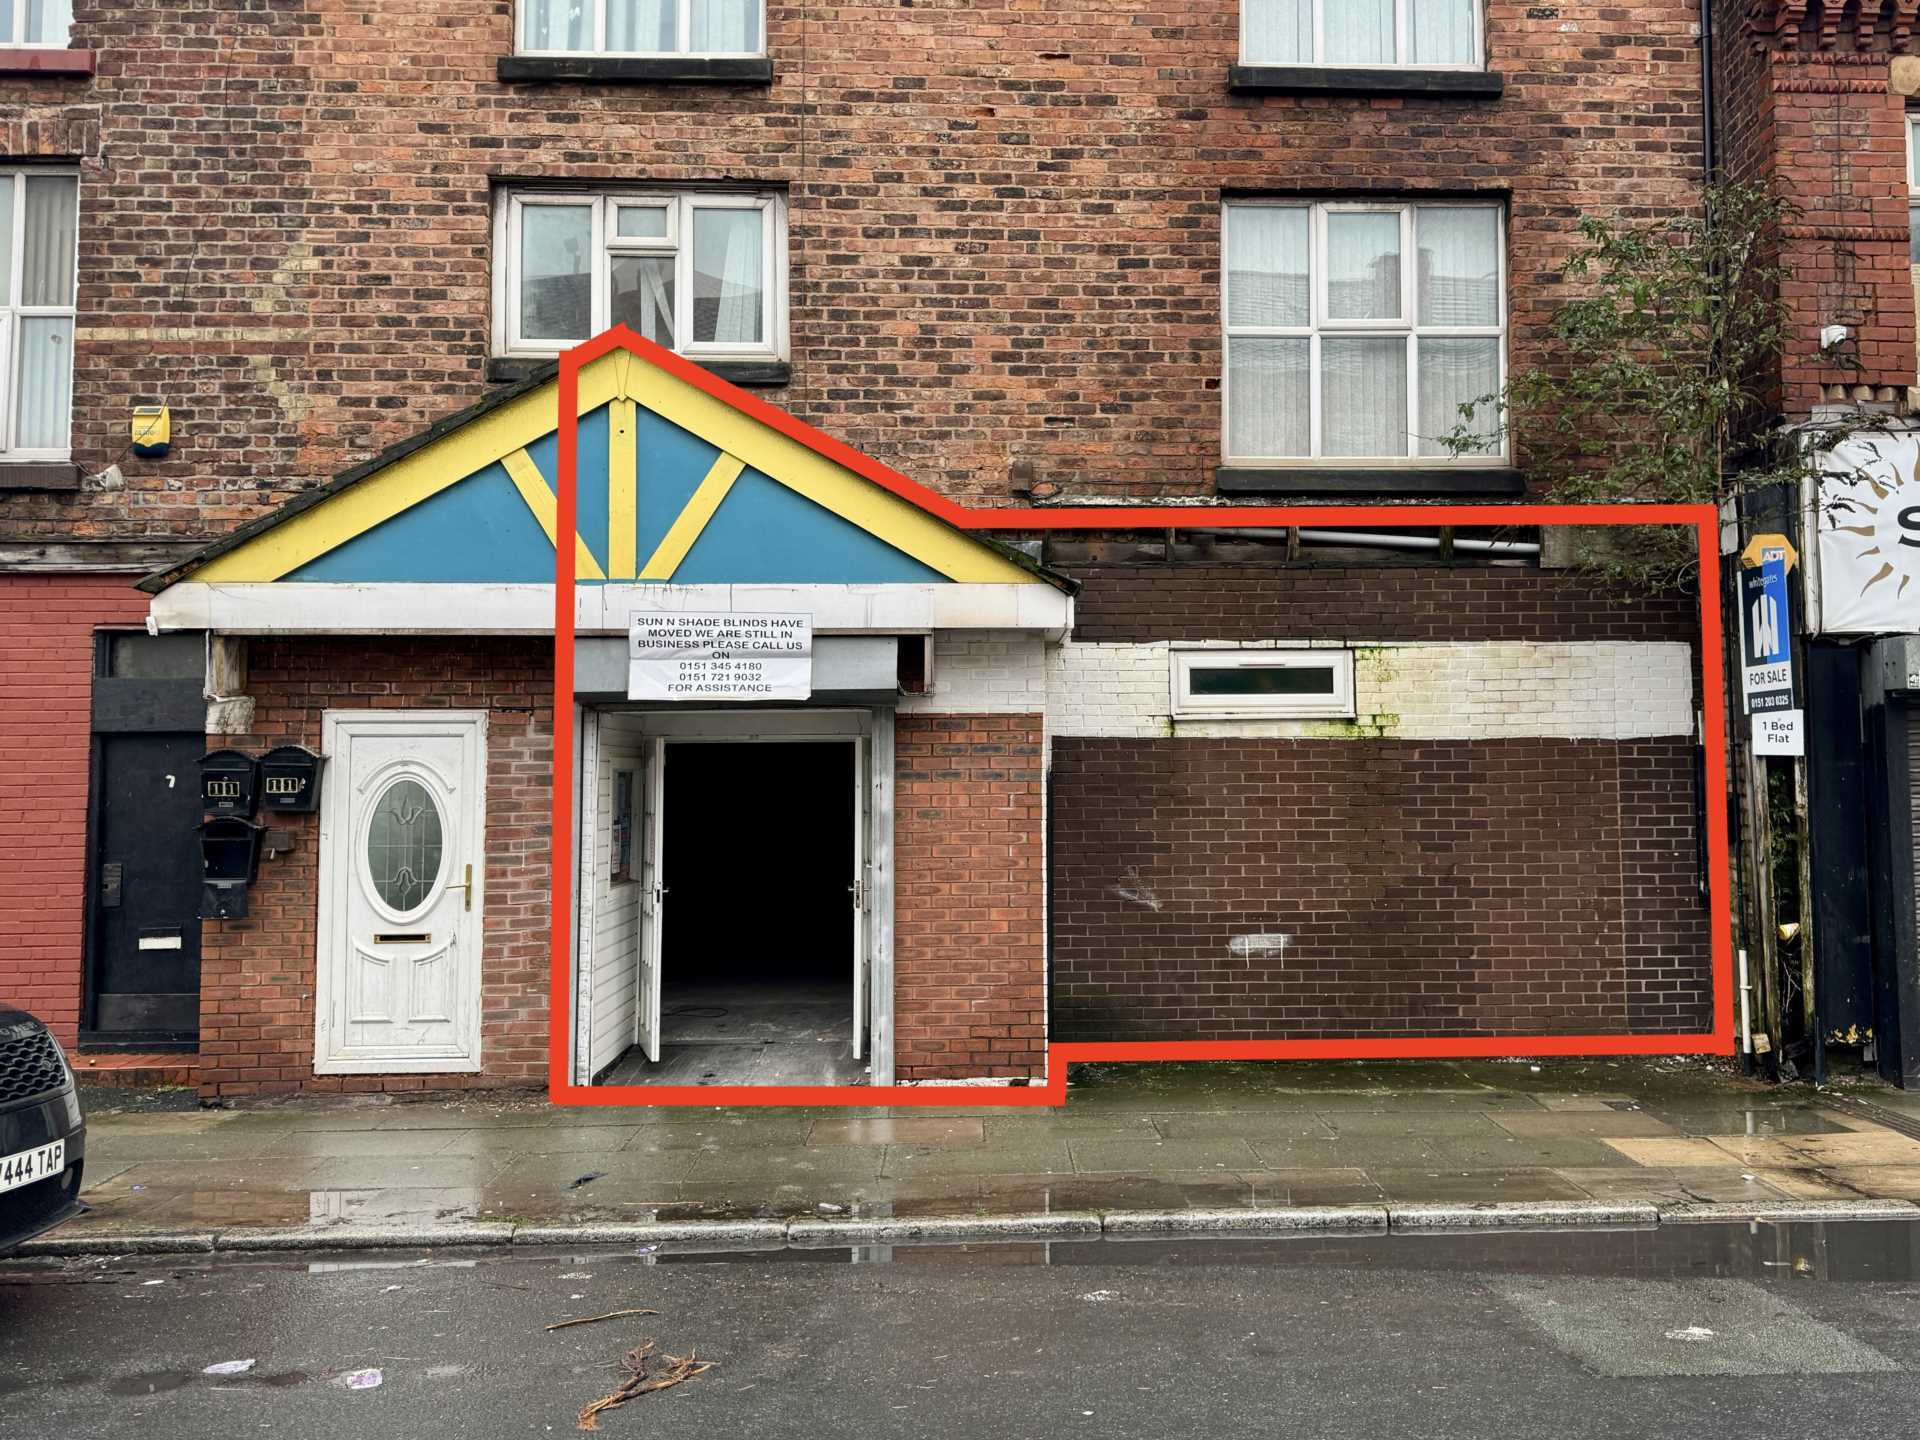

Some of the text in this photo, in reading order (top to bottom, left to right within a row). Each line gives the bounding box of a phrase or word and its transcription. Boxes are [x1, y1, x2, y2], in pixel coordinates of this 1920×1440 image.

[1763, 551, 1785, 561] ADT
[637, 617, 804, 629] SUN N SHADE BLINDS HAVE
[648, 629, 793, 639] MOVED WE ARE STILL IN
[638, 639, 803, 650] BUSINESS PLEASE CALL US
[711, 651, 730, 660] ON
[679, 662, 762, 671] 0151 345 4180
[679, 673, 762, 681] 0151 721 9032
[1749, 668, 1787, 686] FOR SALE
[667, 683, 773, 692] FOR ASSISTANCE
[1751, 694, 1789, 708] 0151 203 0325
[1762, 721, 1794, 731] 1 Bed
[1767, 733, 1790, 743] Flat
[165, 774, 176, 789] 7
[270, 779, 295, 792] 11
[211, 783, 237, 795] 11
[0, 1145, 62, 1185] 444 TAP
